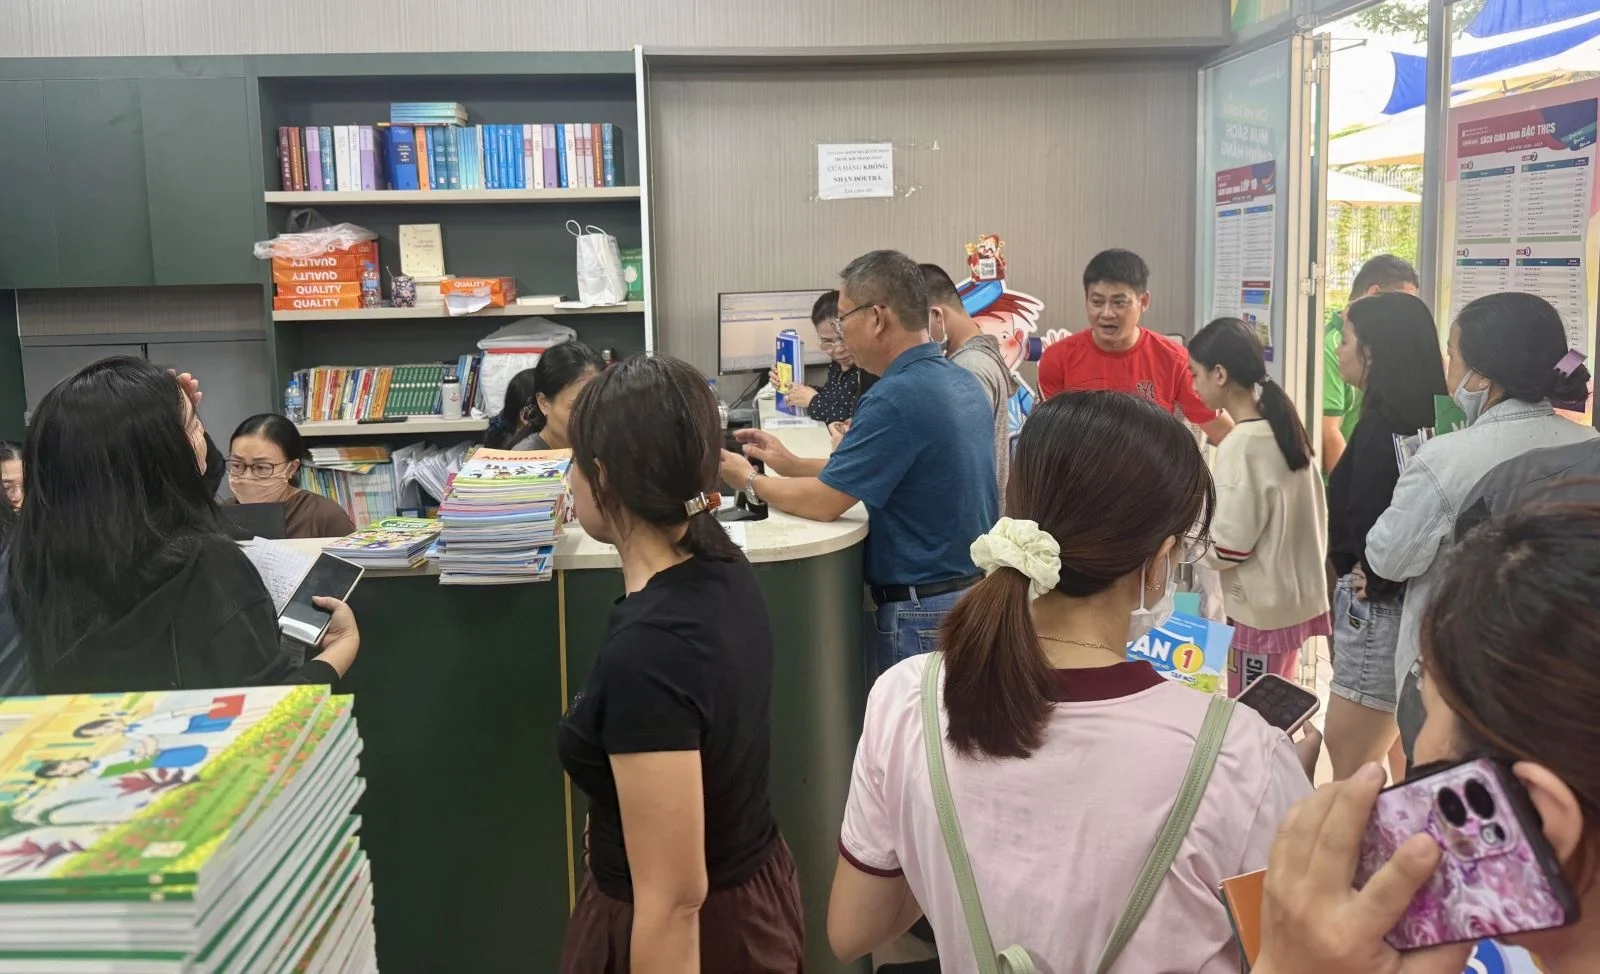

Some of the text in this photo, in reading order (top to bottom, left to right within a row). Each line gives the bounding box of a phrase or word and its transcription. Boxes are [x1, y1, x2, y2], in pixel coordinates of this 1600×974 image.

[1537, 122, 1556, 135] THCS
[291, 258, 337, 267] QUALITY
[292, 271, 337, 280] QUALITY
[454, 280, 486, 288] QUALITY
[296, 285, 341, 294] QUALITY
[293, 298, 340, 308] QUALITY
[1182, 648, 1194, 669] 1
